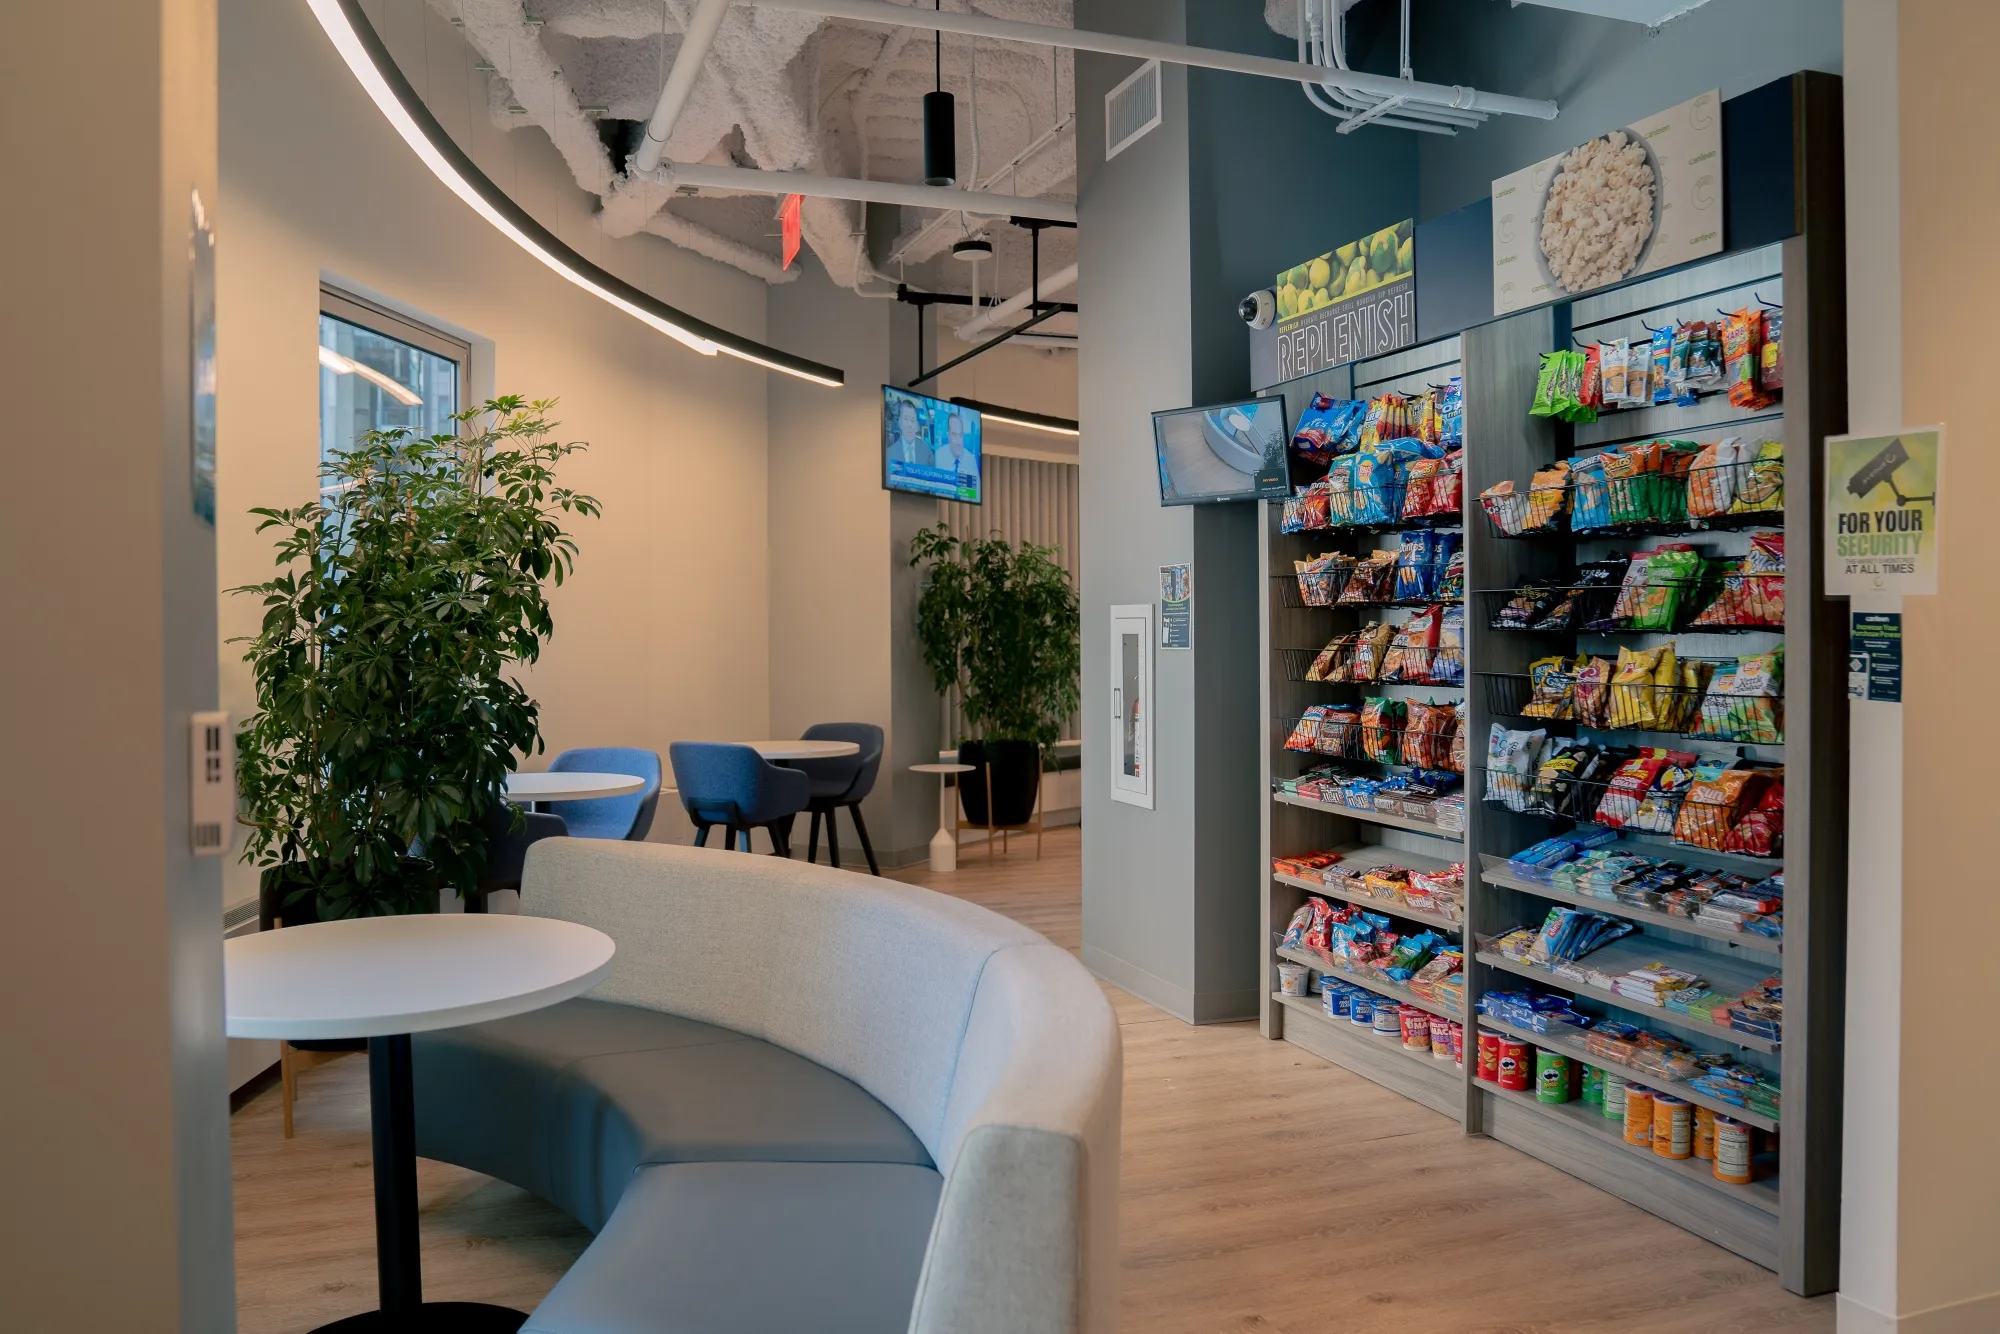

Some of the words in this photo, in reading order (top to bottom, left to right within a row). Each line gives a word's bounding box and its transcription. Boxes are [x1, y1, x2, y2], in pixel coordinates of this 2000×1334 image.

[1688, 150, 1717, 166] canteen
[1495, 186, 1516, 199] canteen
[1689, 231, 1717, 245] canteen
[1277, 290, 1415, 382] REPLENISH
[1572, 455, 1601, 472] CORNER
[1838, 512, 1870, 534] FOR
[1874, 509, 1923, 533] YOUR
[1837, 532, 1923, 557] SECURITY
[1845, 565, 1858, 574] AT
[1860, 564, 1880, 574] ALL
[1882, 563, 1915, 574] TIMES
